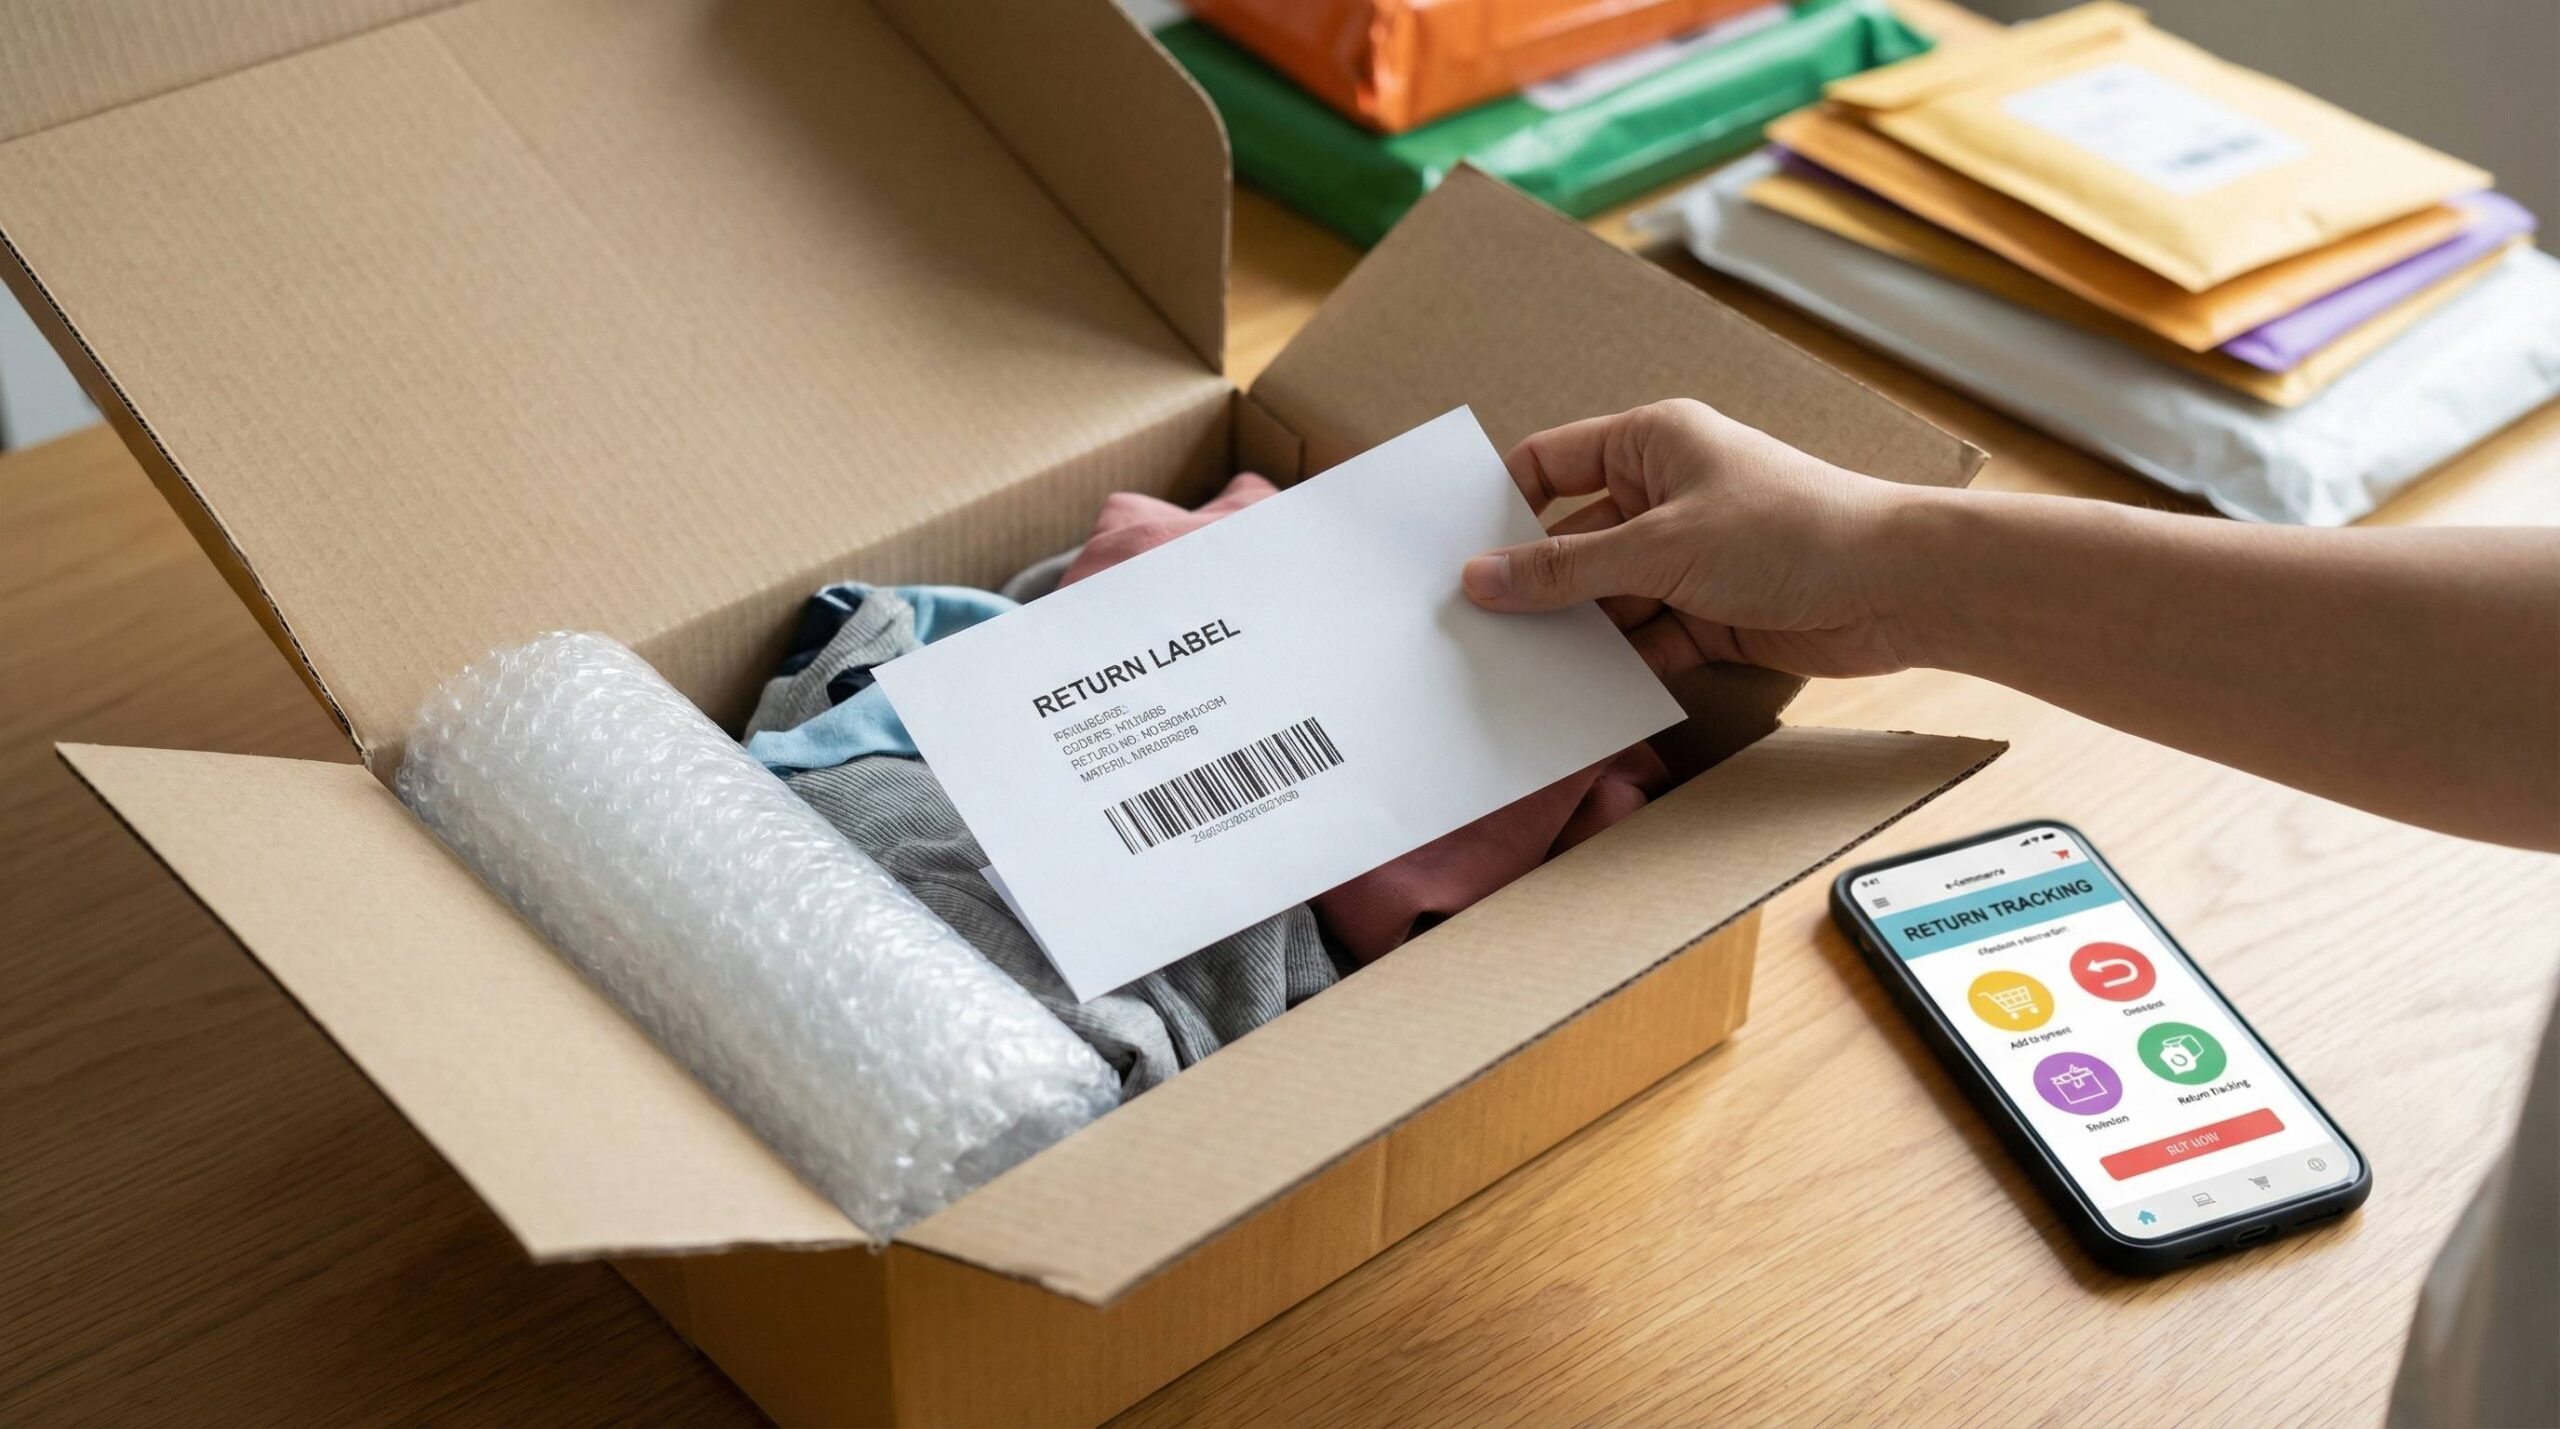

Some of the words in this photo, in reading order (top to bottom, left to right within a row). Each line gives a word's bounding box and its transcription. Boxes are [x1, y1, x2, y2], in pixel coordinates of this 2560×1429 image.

[1033, 656, 1147, 718] RETURN
[1148, 619, 1241, 668] LABEL
[1903, 907, 1989, 942] RETURN
[1989, 879, 2094, 917] TRACKING
